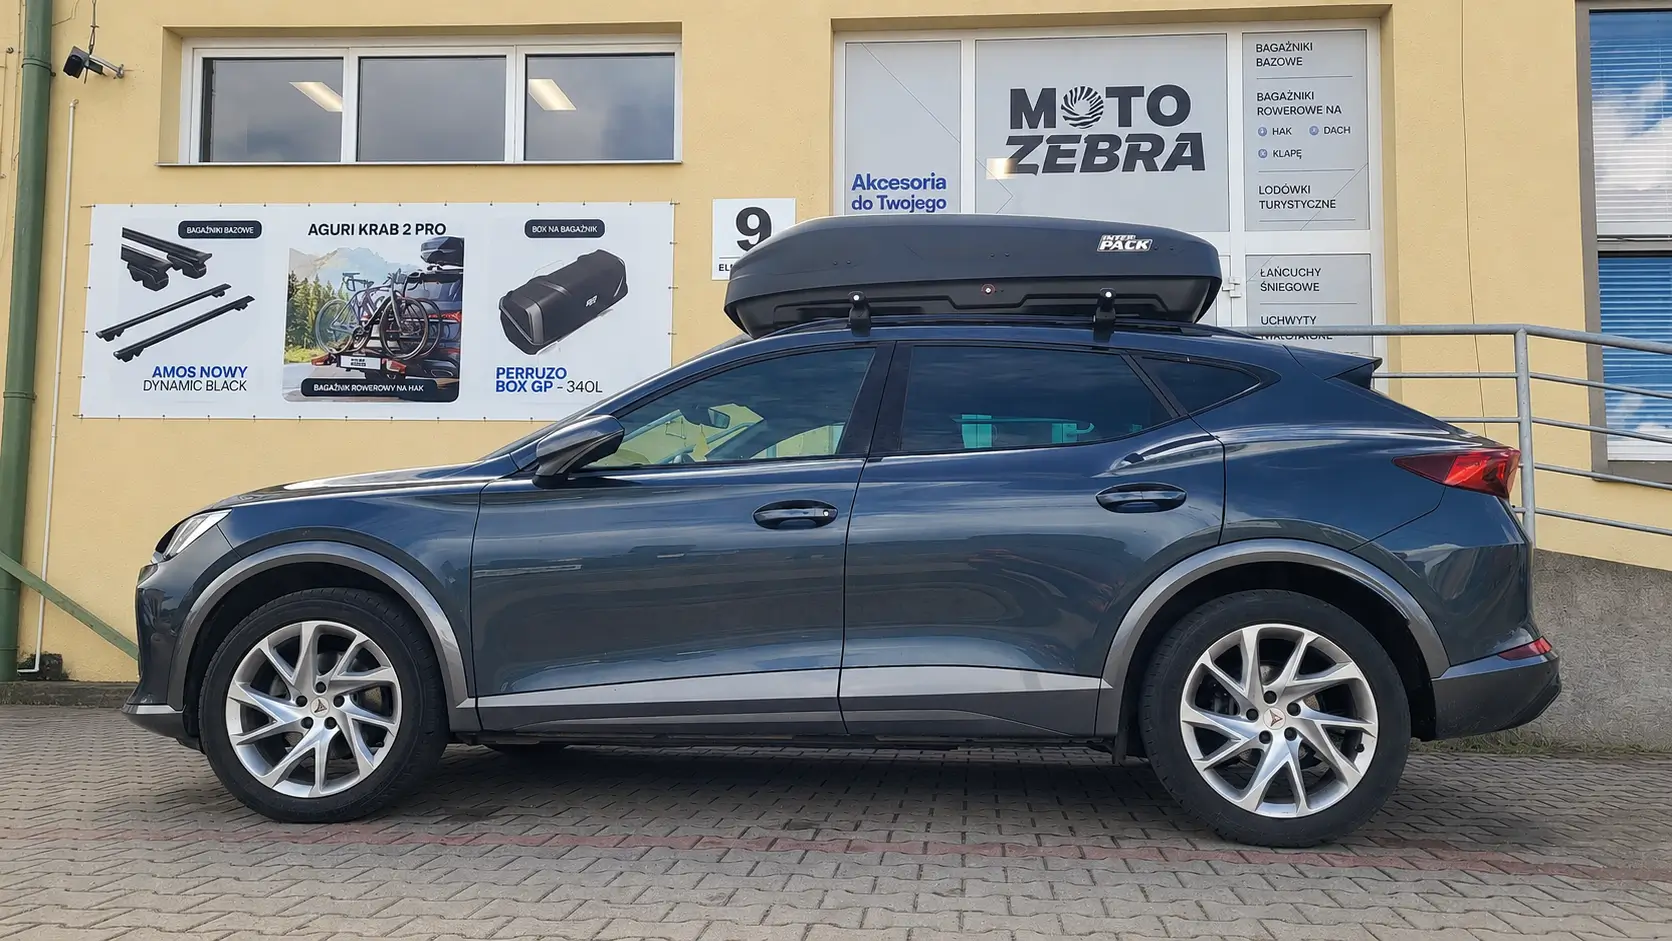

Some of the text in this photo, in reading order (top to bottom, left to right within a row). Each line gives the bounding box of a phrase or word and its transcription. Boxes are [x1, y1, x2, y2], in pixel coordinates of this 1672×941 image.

[1256, 41, 1313, 52] BAGAŻNIKI
[1256, 57, 1303, 67] BAZOWE
[1256, 90, 1314, 102] BAGAŻNIKI
[1010, 84, 1192, 130] MOTO
[1257, 105, 1342, 116] ROWEROWE NA
[1272, 127, 1292, 136] HAK
[1324, 126, 1351, 134] DACH
[1005, 132, 1206, 176] ZEBRA
[1272, 150, 1302, 160] KLAPĘ
[851, 172, 947, 192] Akcesoria
[1258, 183, 1311, 194] LODÓWKI
[852, 194, 947, 214] do Twojego
[1259, 199, 1336, 210] TURYSTYCZNE
[308, 224, 446, 236] AGURI KRAB 2 PRO
[736, 206, 772, 252] 9
[1100, 240, 1150, 250] PACK
[1260, 266, 1322, 278] ŁAŃCUCHY
[1260, 282, 1320, 292] ŚNIEGOWE
[1260, 316, 1317, 325] UCHWYTY
[152, 366, 248, 378] AMOS NOWY
[496, 367, 567, 380] PERRUZO
[142, 380, 247, 392] DYNAMIC BLACK
[496, 380, 527, 393] BOX
[532, 380, 554, 393] GP
[566, 380, 602, 394] 340L
